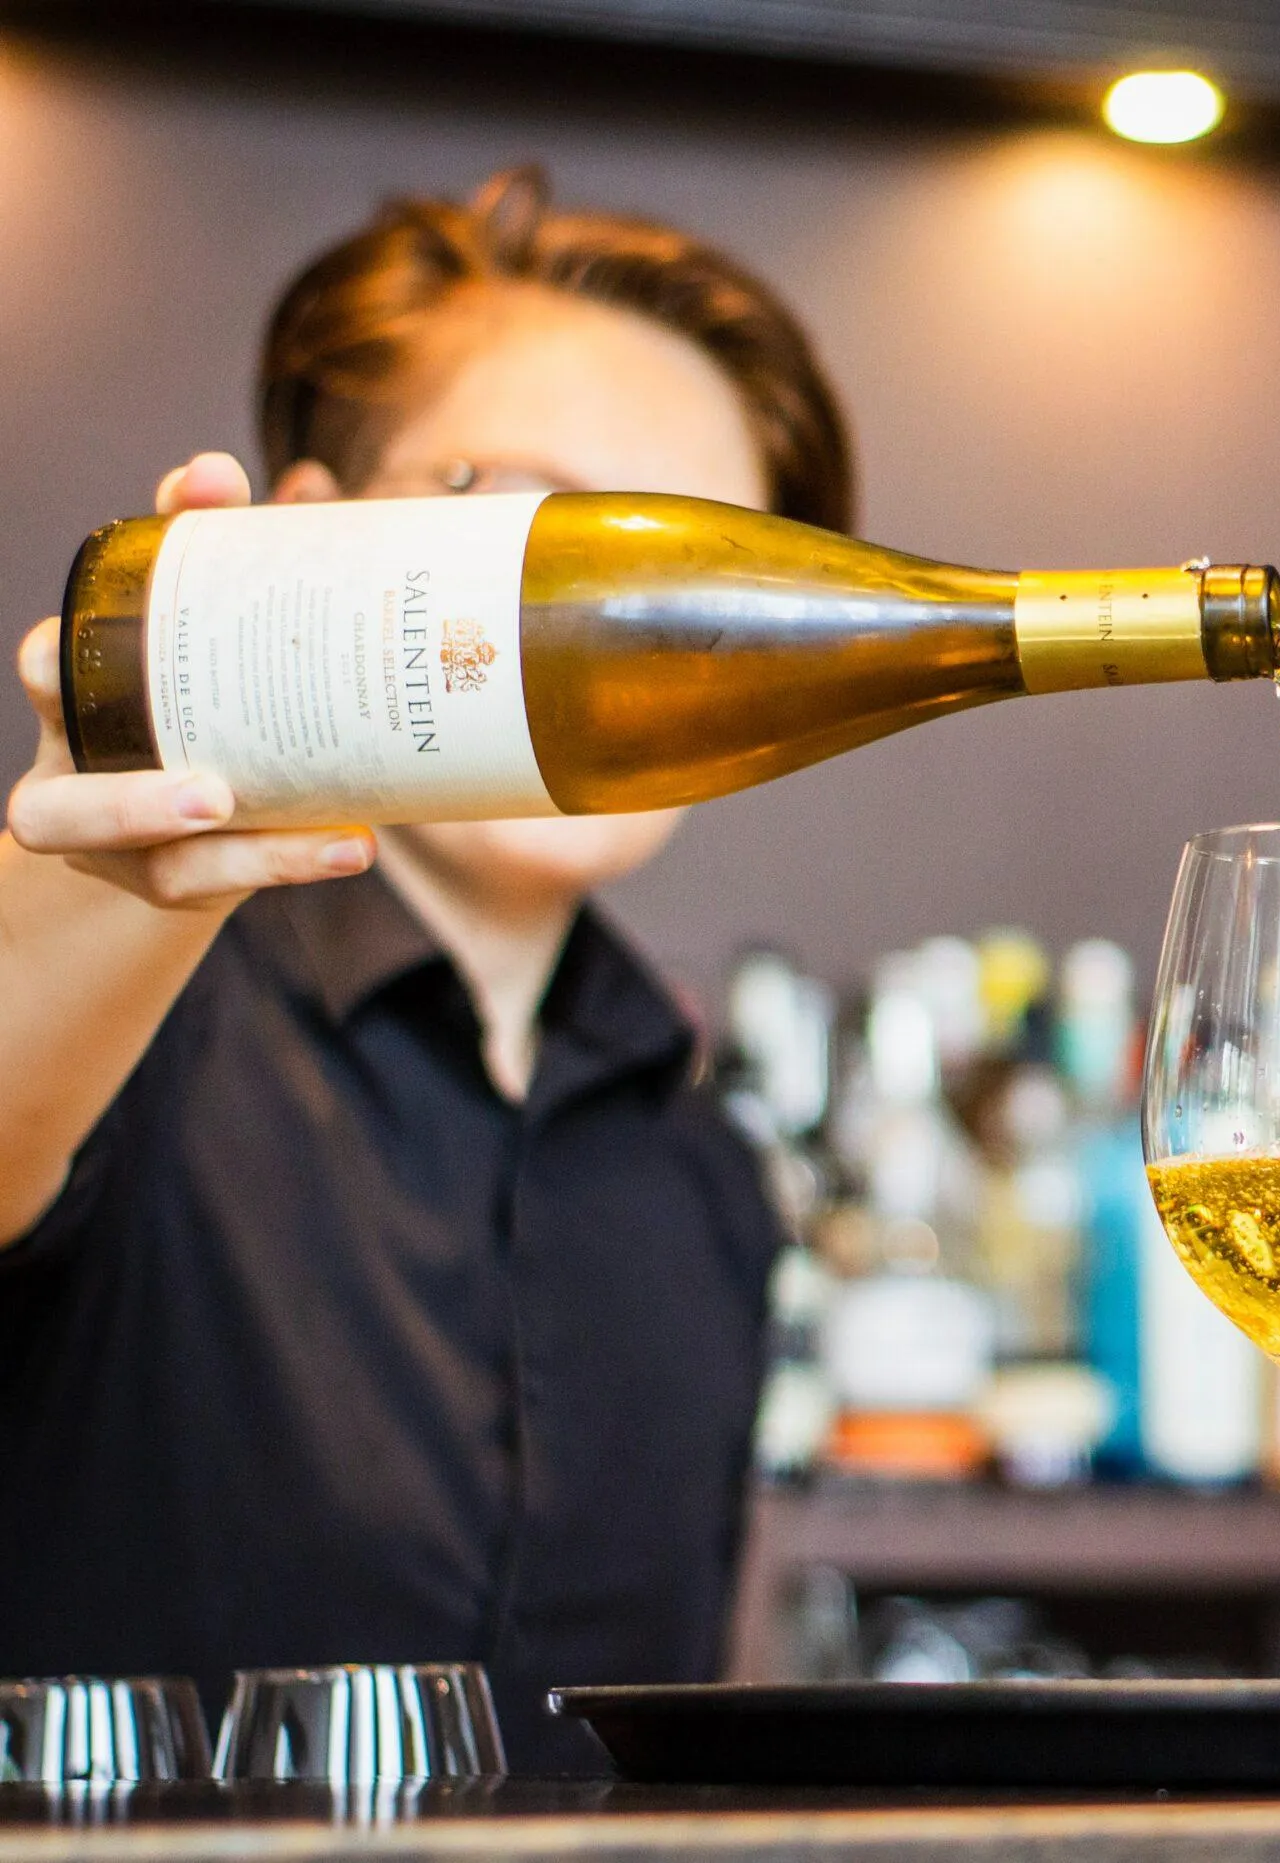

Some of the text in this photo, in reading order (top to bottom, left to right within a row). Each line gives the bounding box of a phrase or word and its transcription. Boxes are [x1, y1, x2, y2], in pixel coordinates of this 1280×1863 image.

[178, 607, 197, 742] VALLE DE UCO
[354, 611, 371, 720] CHARDONNAY
[383, 649, 402, 732] SELECTION
[402, 570, 441, 753] SALENTEIN
